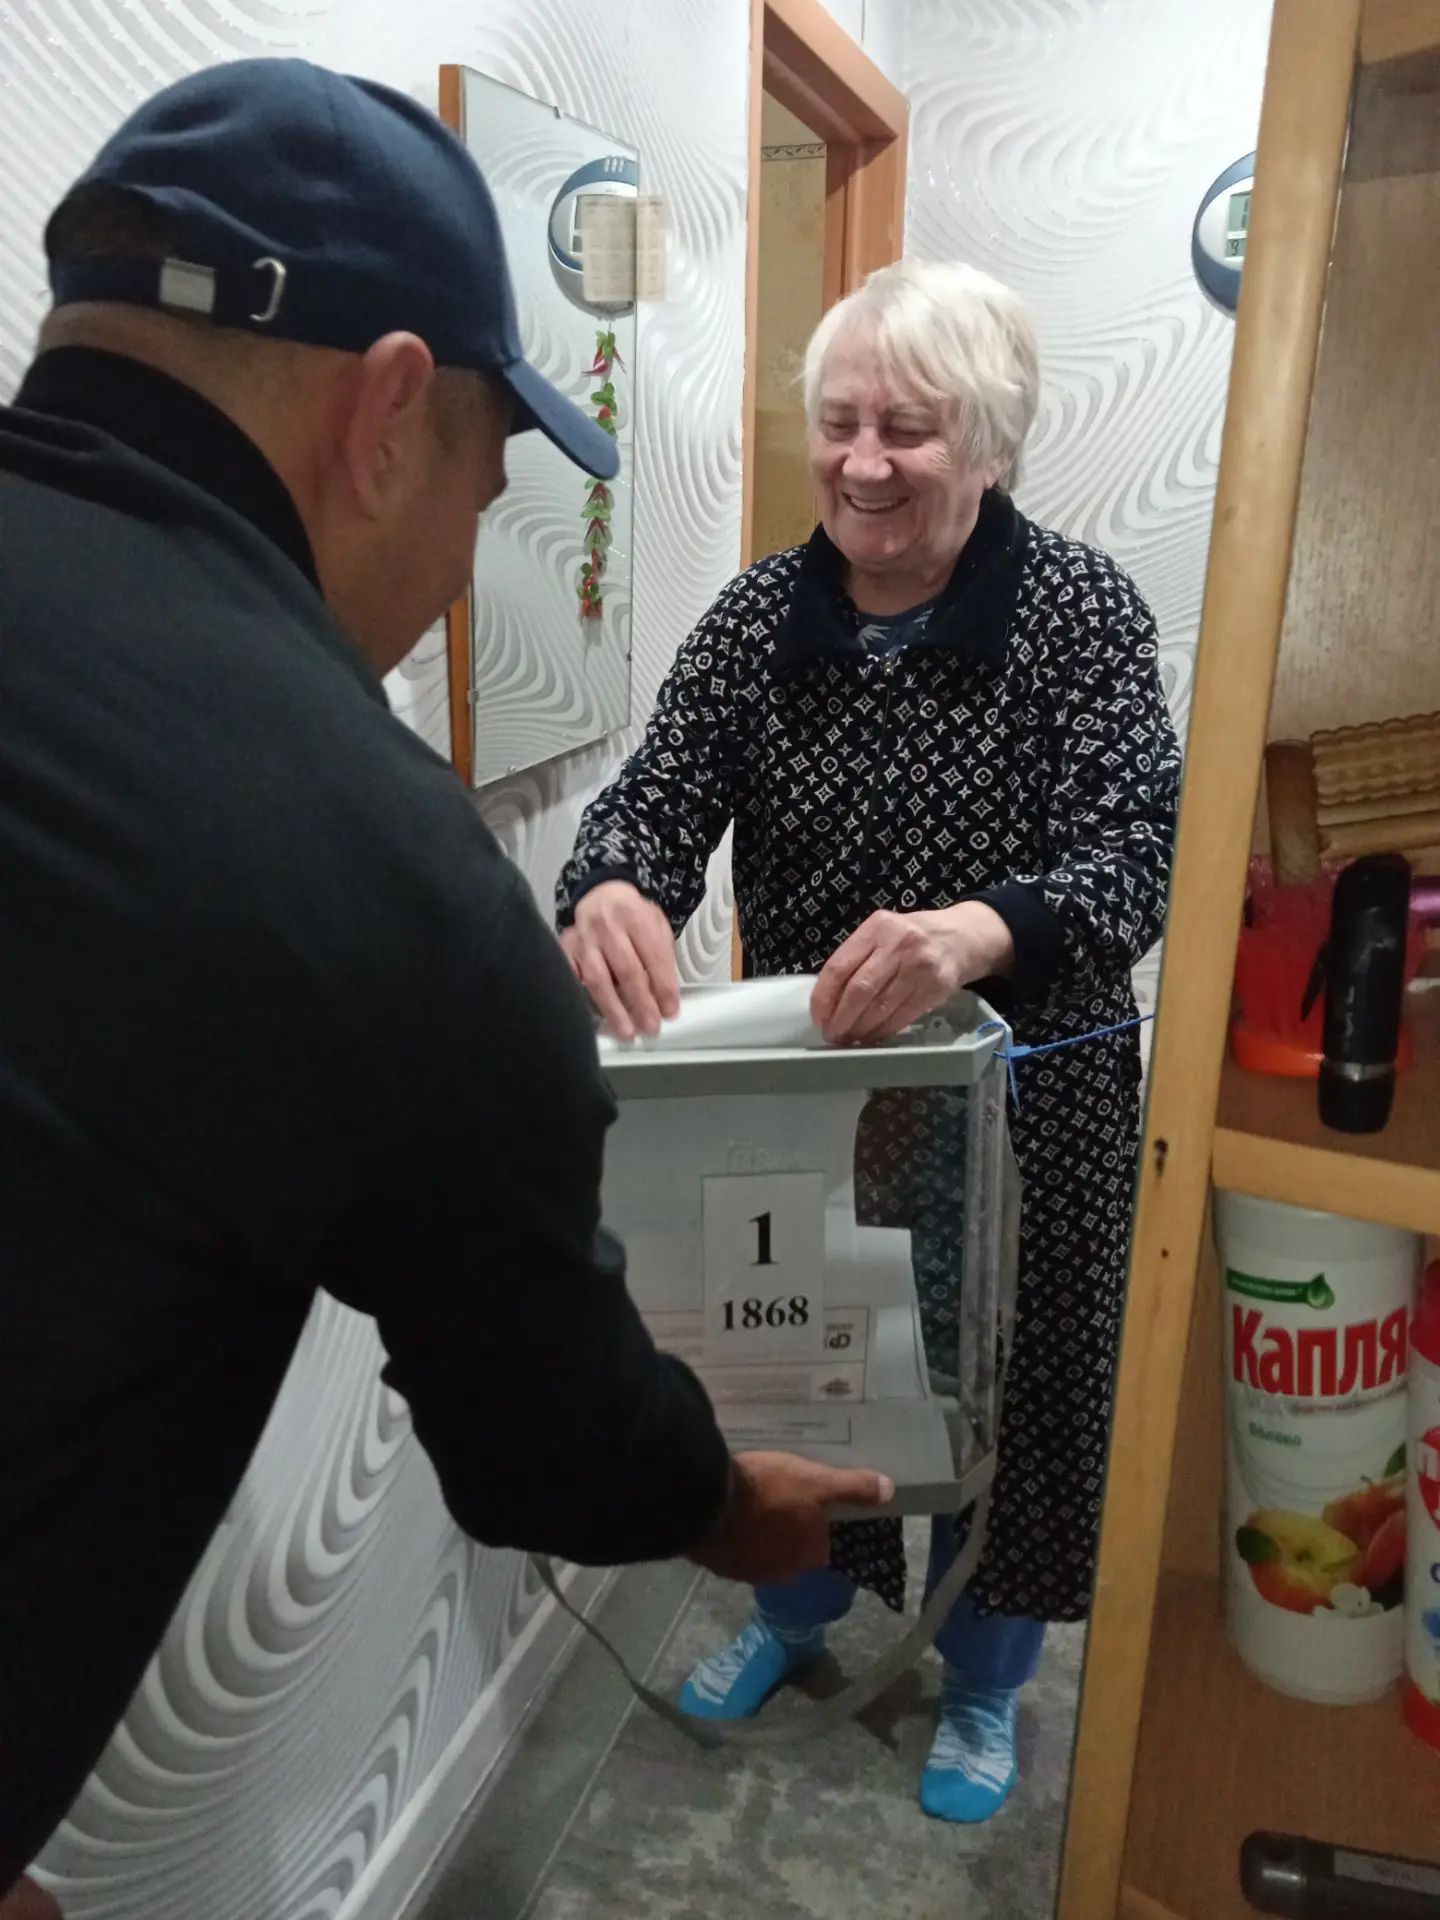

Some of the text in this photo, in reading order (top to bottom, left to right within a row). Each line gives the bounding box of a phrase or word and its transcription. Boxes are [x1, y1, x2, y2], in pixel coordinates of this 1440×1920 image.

[748, 1210, 780, 1266] 1
[723, 1295, 809, 1331] 1868
[1232, 1303, 1408, 1397] Капля
